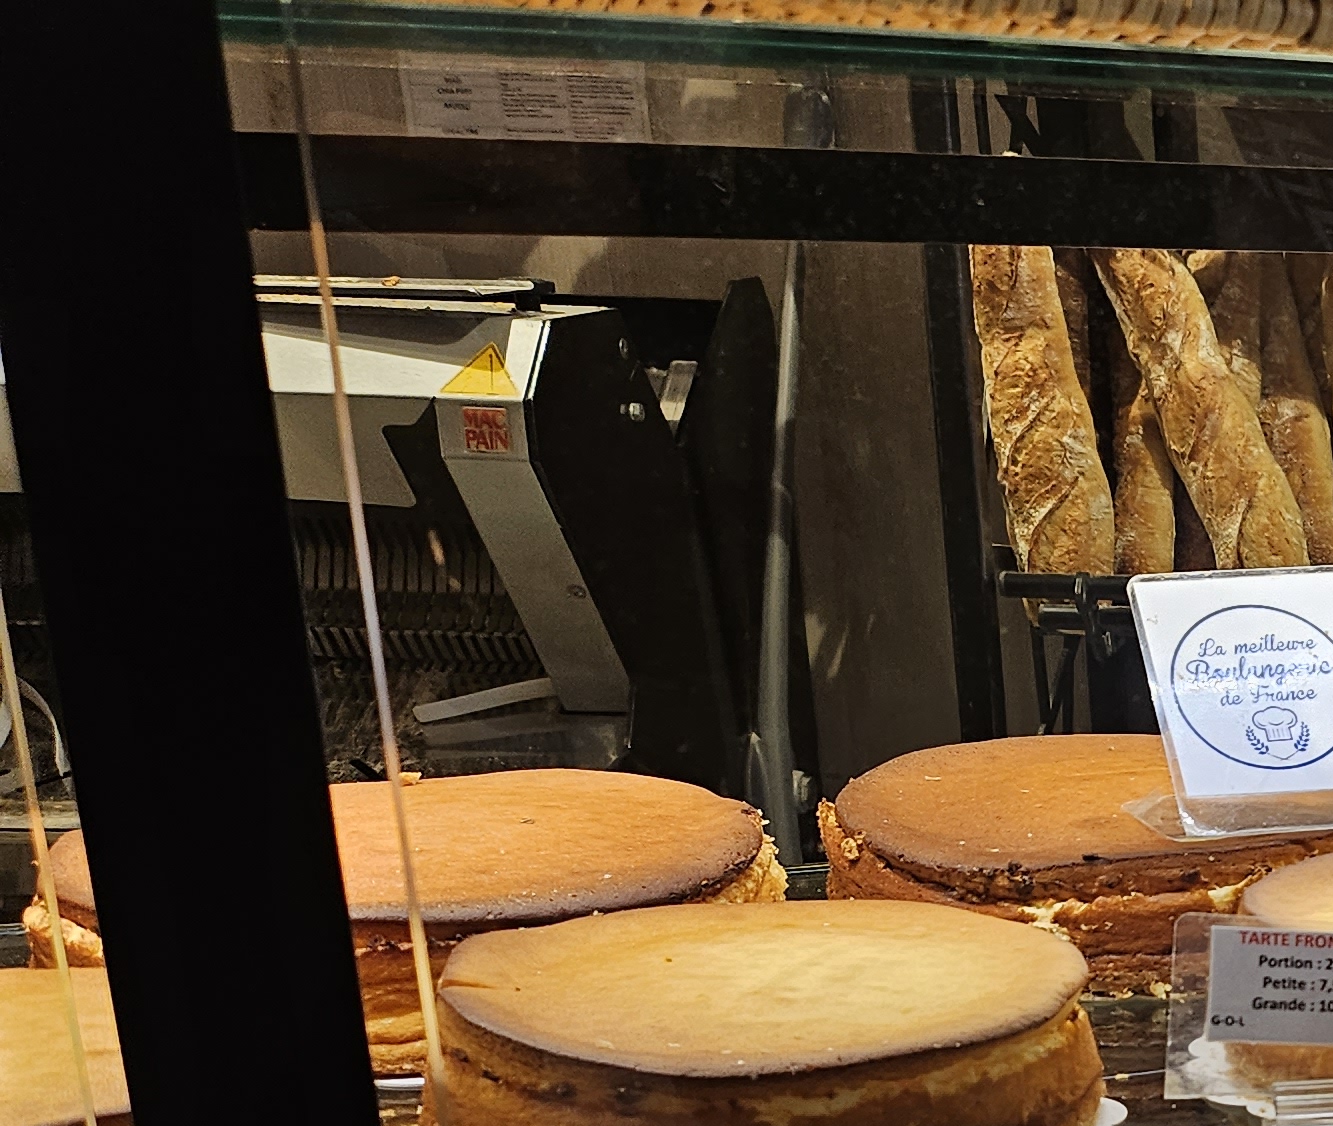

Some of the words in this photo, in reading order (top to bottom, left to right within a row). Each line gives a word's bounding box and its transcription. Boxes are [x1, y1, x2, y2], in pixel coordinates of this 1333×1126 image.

[465, 428, 509, 449] PAIN
[1198, 638, 1227, 657] La
[1234, 634, 1318, 655] meilleure
[1220, 691, 1242, 706] de
[1251, 687, 1318, 703] France
[1238, 930, 1290, 948] TARTE
[1258, 954, 1314, 970] Portion
[1262, 975, 1307, 990] Petite
[1252, 996, 1307, 1013] Grande
[1210, 1015, 1246, 1028] G-O-L
